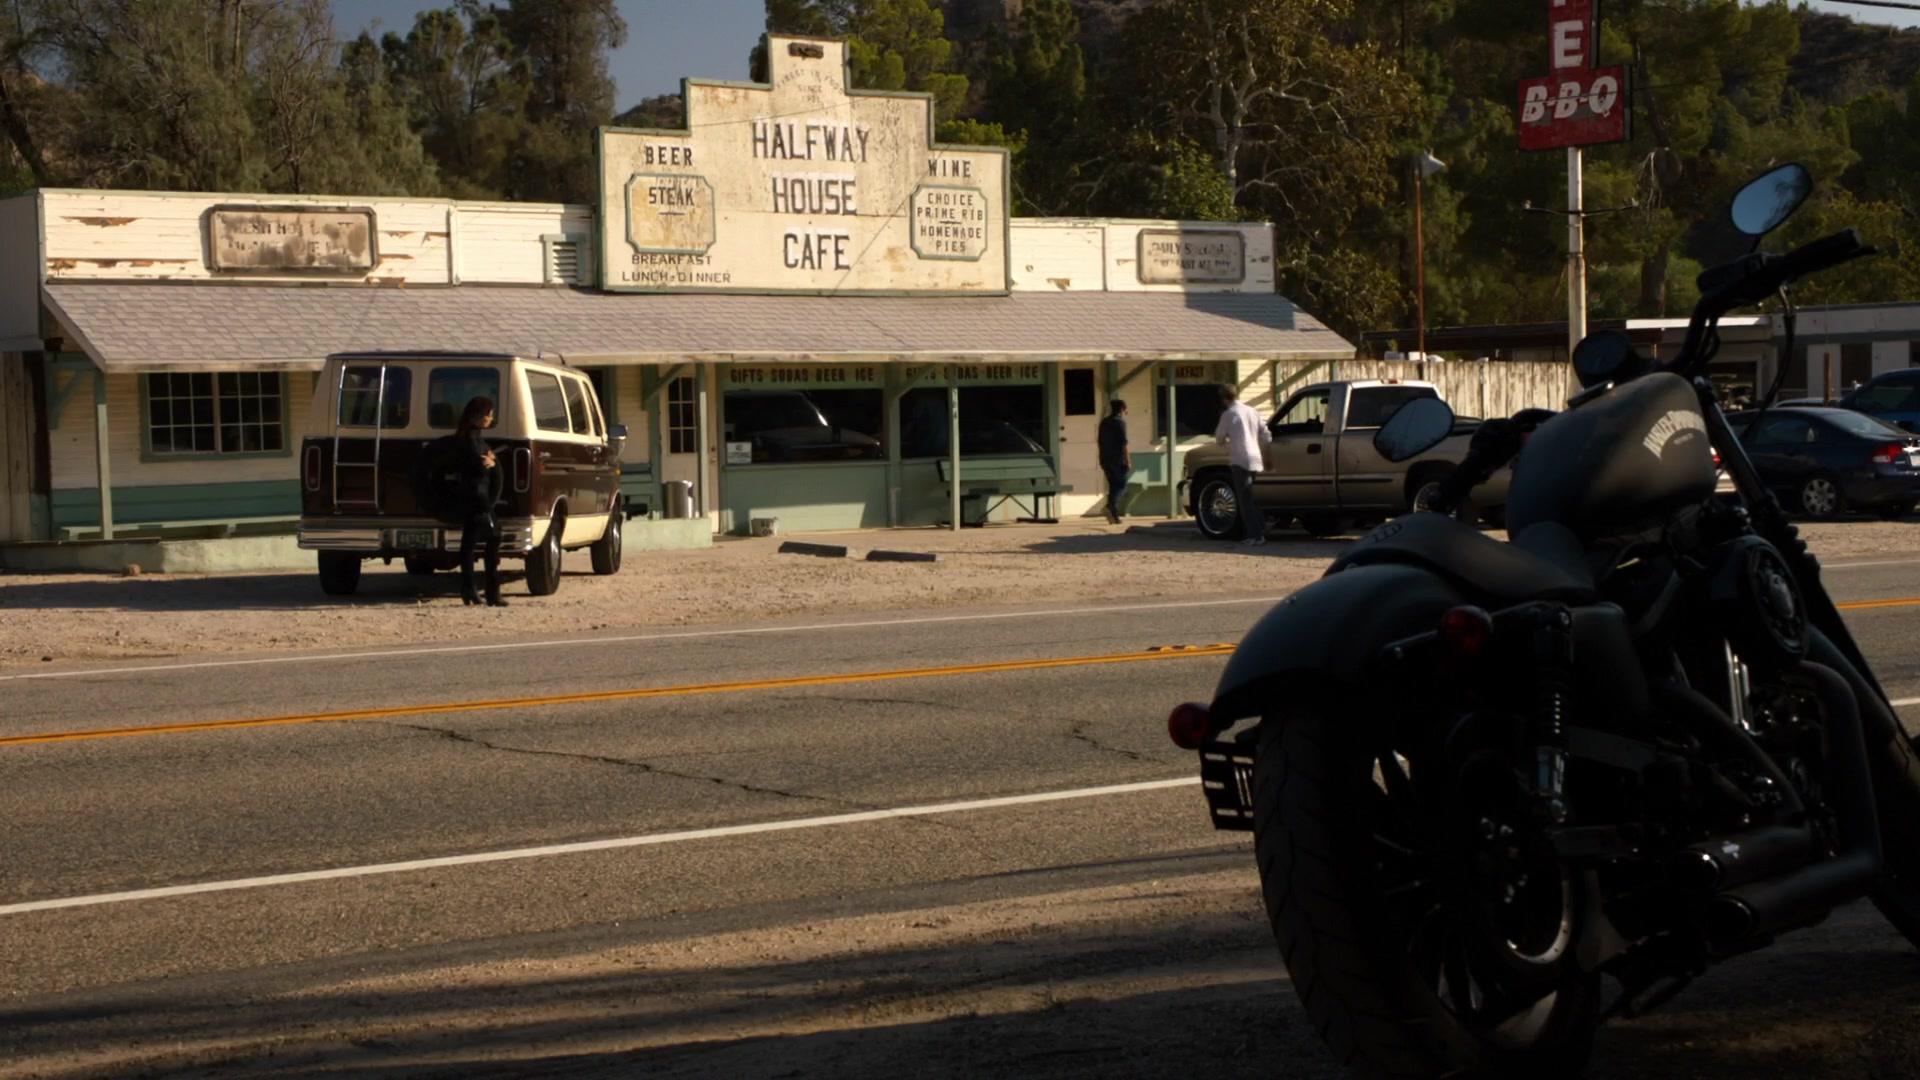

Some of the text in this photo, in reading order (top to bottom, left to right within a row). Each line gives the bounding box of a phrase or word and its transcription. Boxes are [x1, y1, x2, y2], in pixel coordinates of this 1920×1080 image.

[1521, 75, 1618, 122] B-B-Q
[752, 121, 870, 163] HALFWAY
[645, 145, 693, 167] BEER
[928, 159, 972, 178] WINE
[648, 186, 695, 206] STEAK
[772, 176, 857, 216] HOUSE
[927, 192, 974, 207] CHOICE
[917, 207, 983, 221] PRIME RIB
[920, 225, 982, 239] HOMEMADE
[783, 232, 850, 270] CAFE
[935, 240, 967, 253] PIES
[631, 253, 713, 266] BREAKFAST
[730, 367, 874, 383] GIFTS SODAS BEER ICE
[986, 365, 1012, 380] BEER
[1020, 365, 1039, 378] ICE
